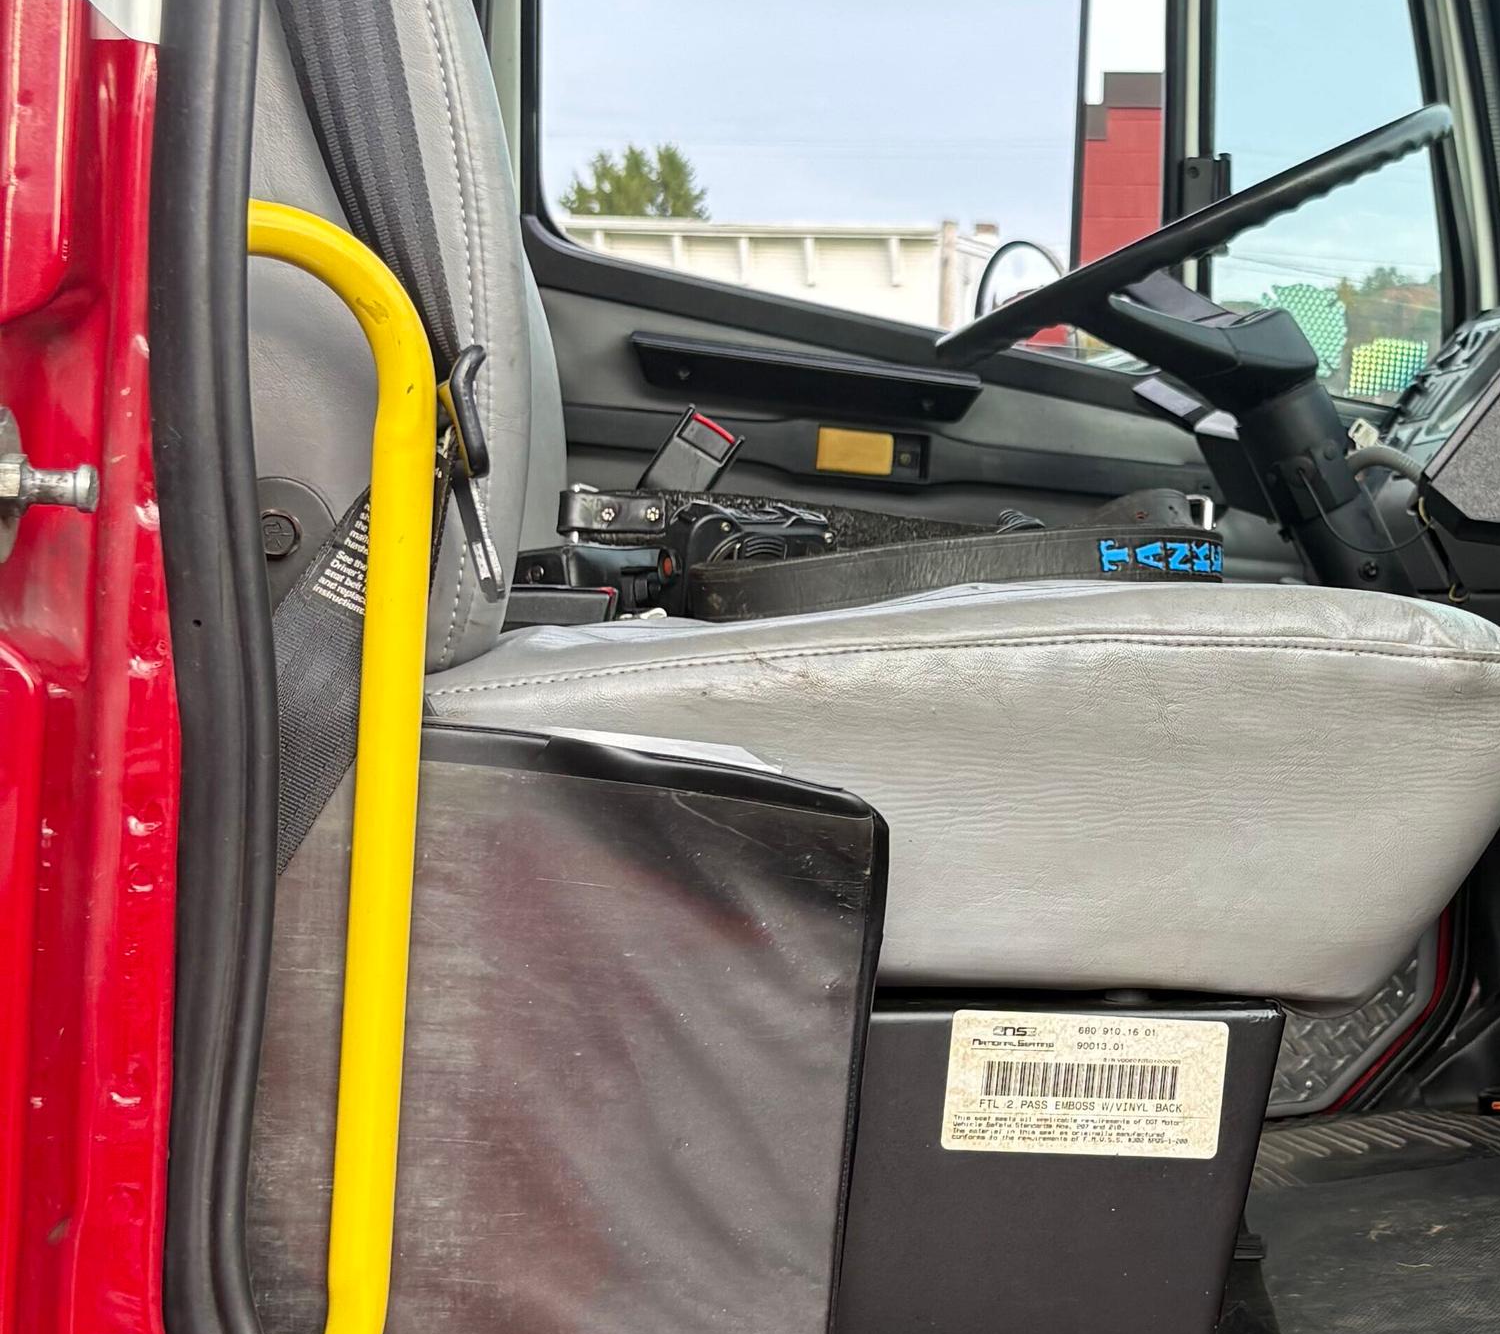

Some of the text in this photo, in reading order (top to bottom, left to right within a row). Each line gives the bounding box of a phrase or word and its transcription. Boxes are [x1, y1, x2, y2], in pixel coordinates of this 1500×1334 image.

[336, 550, 368, 571] See the
[330, 559, 364, 580] Driver's
[318, 576, 338, 589] and
[324, 569, 363, 590] seat belt
[1078, 1026, 1096, 1035] 680
[1076, 1042, 1124, 1051] 90013.01
[979, 1099, 1183, 1113] FTL 2 PASS EMBOSS W/VINYL BACK
